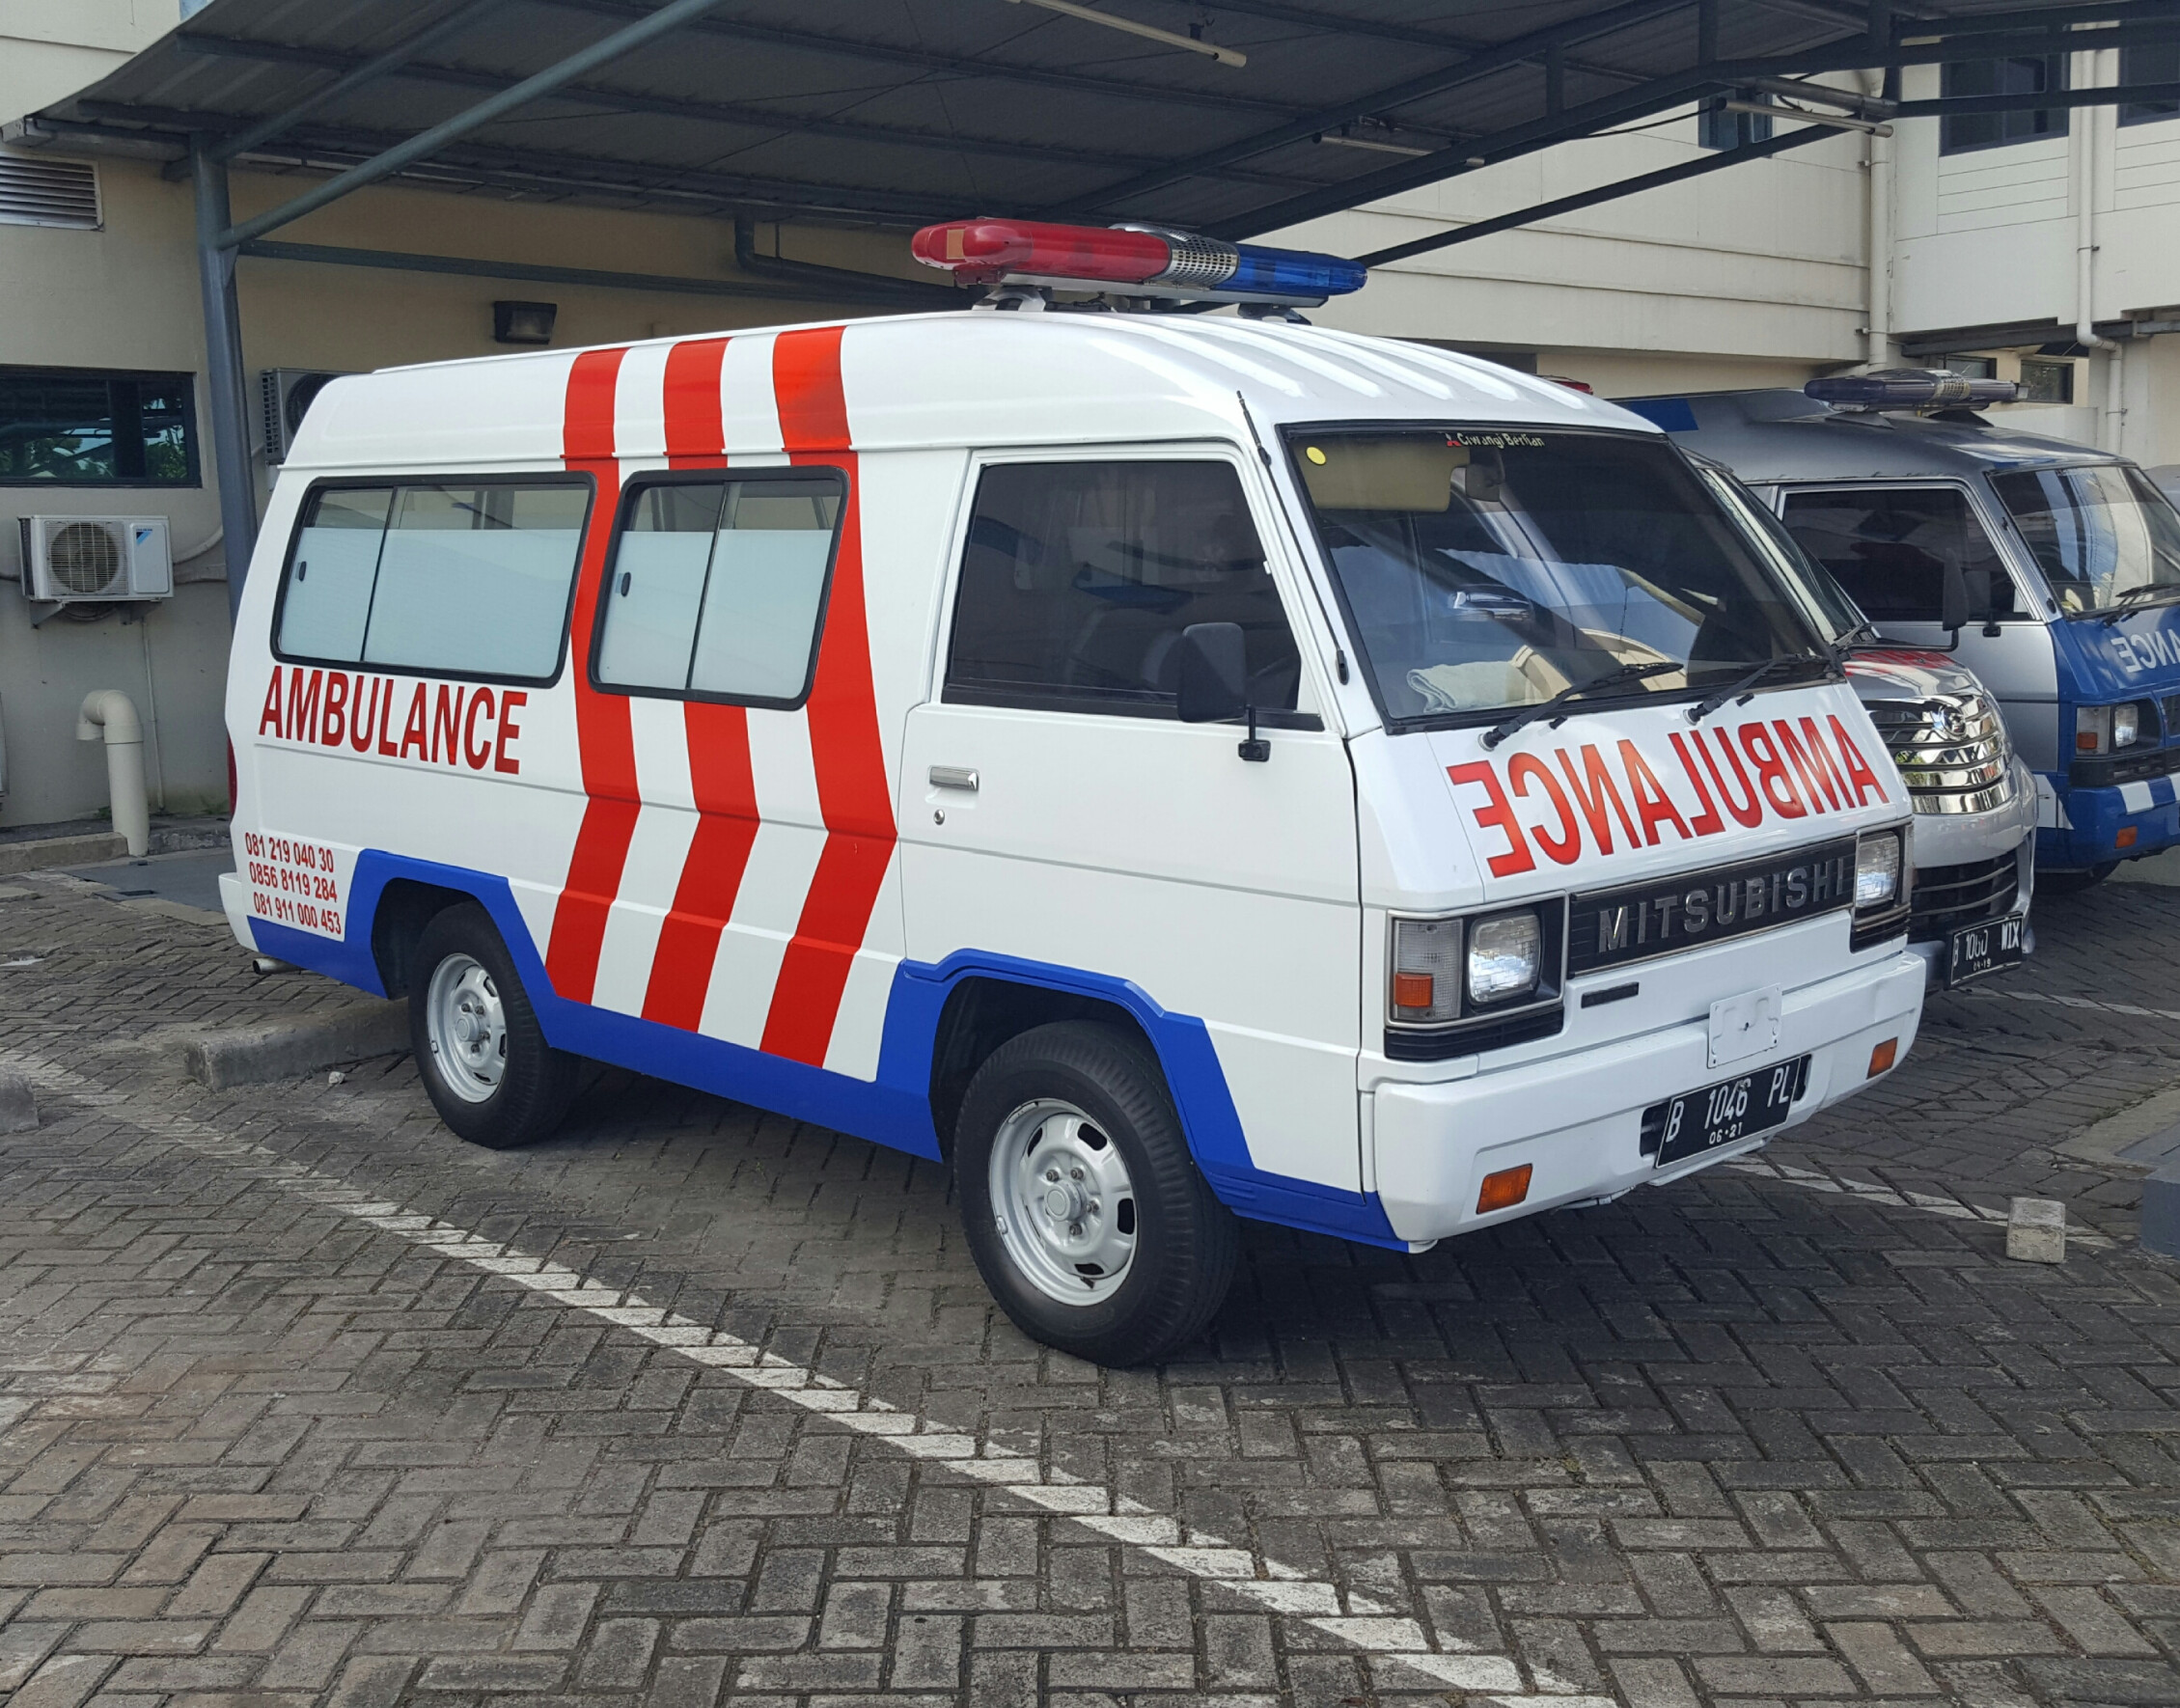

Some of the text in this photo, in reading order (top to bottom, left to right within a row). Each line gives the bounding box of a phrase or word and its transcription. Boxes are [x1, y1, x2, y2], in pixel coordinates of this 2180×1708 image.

[259, 665, 528, 775] AMBULANCE
[245, 832, 334, 873] 081 219 040 30
[249, 861, 338, 903] 0856 8119 284
[253, 892, 342, 935] 081 911 000 453
[1599, 857, 1844, 953] MITSUBISHI
[1951, 938, 1960, 967] B
[1666, 1064, 1790, 1143] B 1046 PL
